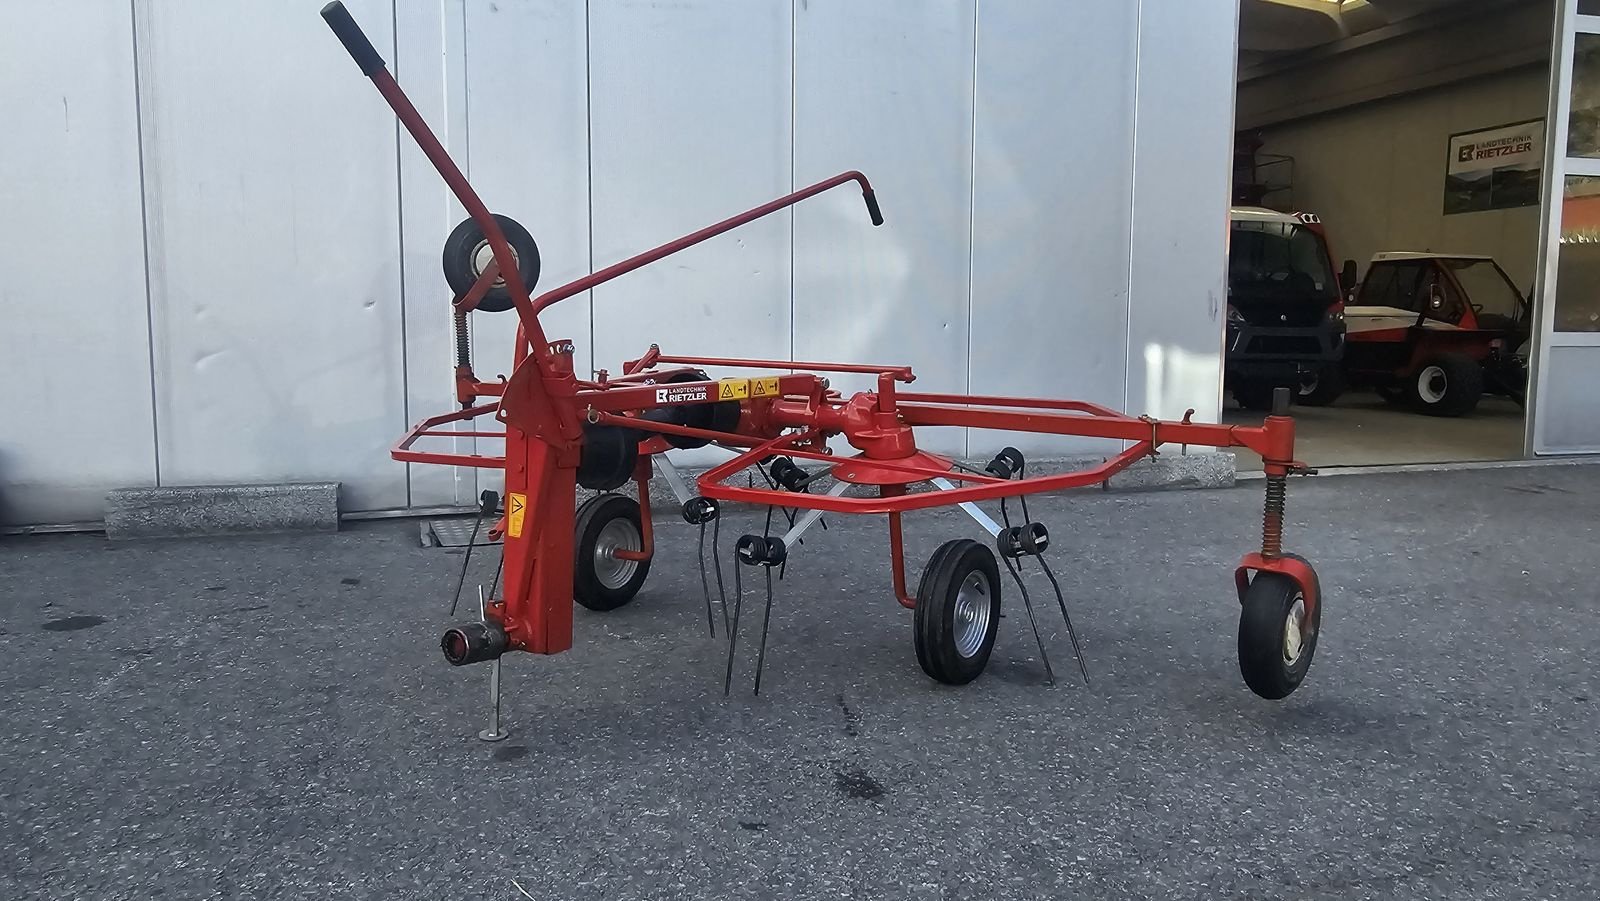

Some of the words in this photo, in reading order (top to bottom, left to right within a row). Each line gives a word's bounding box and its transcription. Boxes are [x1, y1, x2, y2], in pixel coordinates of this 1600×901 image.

[1476, 136, 1532, 149] LANDTECHNIK
[1476, 142, 1531, 160] RIETZLER
[669, 386, 707, 394] LANDTECHNIK
[669, 393, 707, 402] RIETZLER
